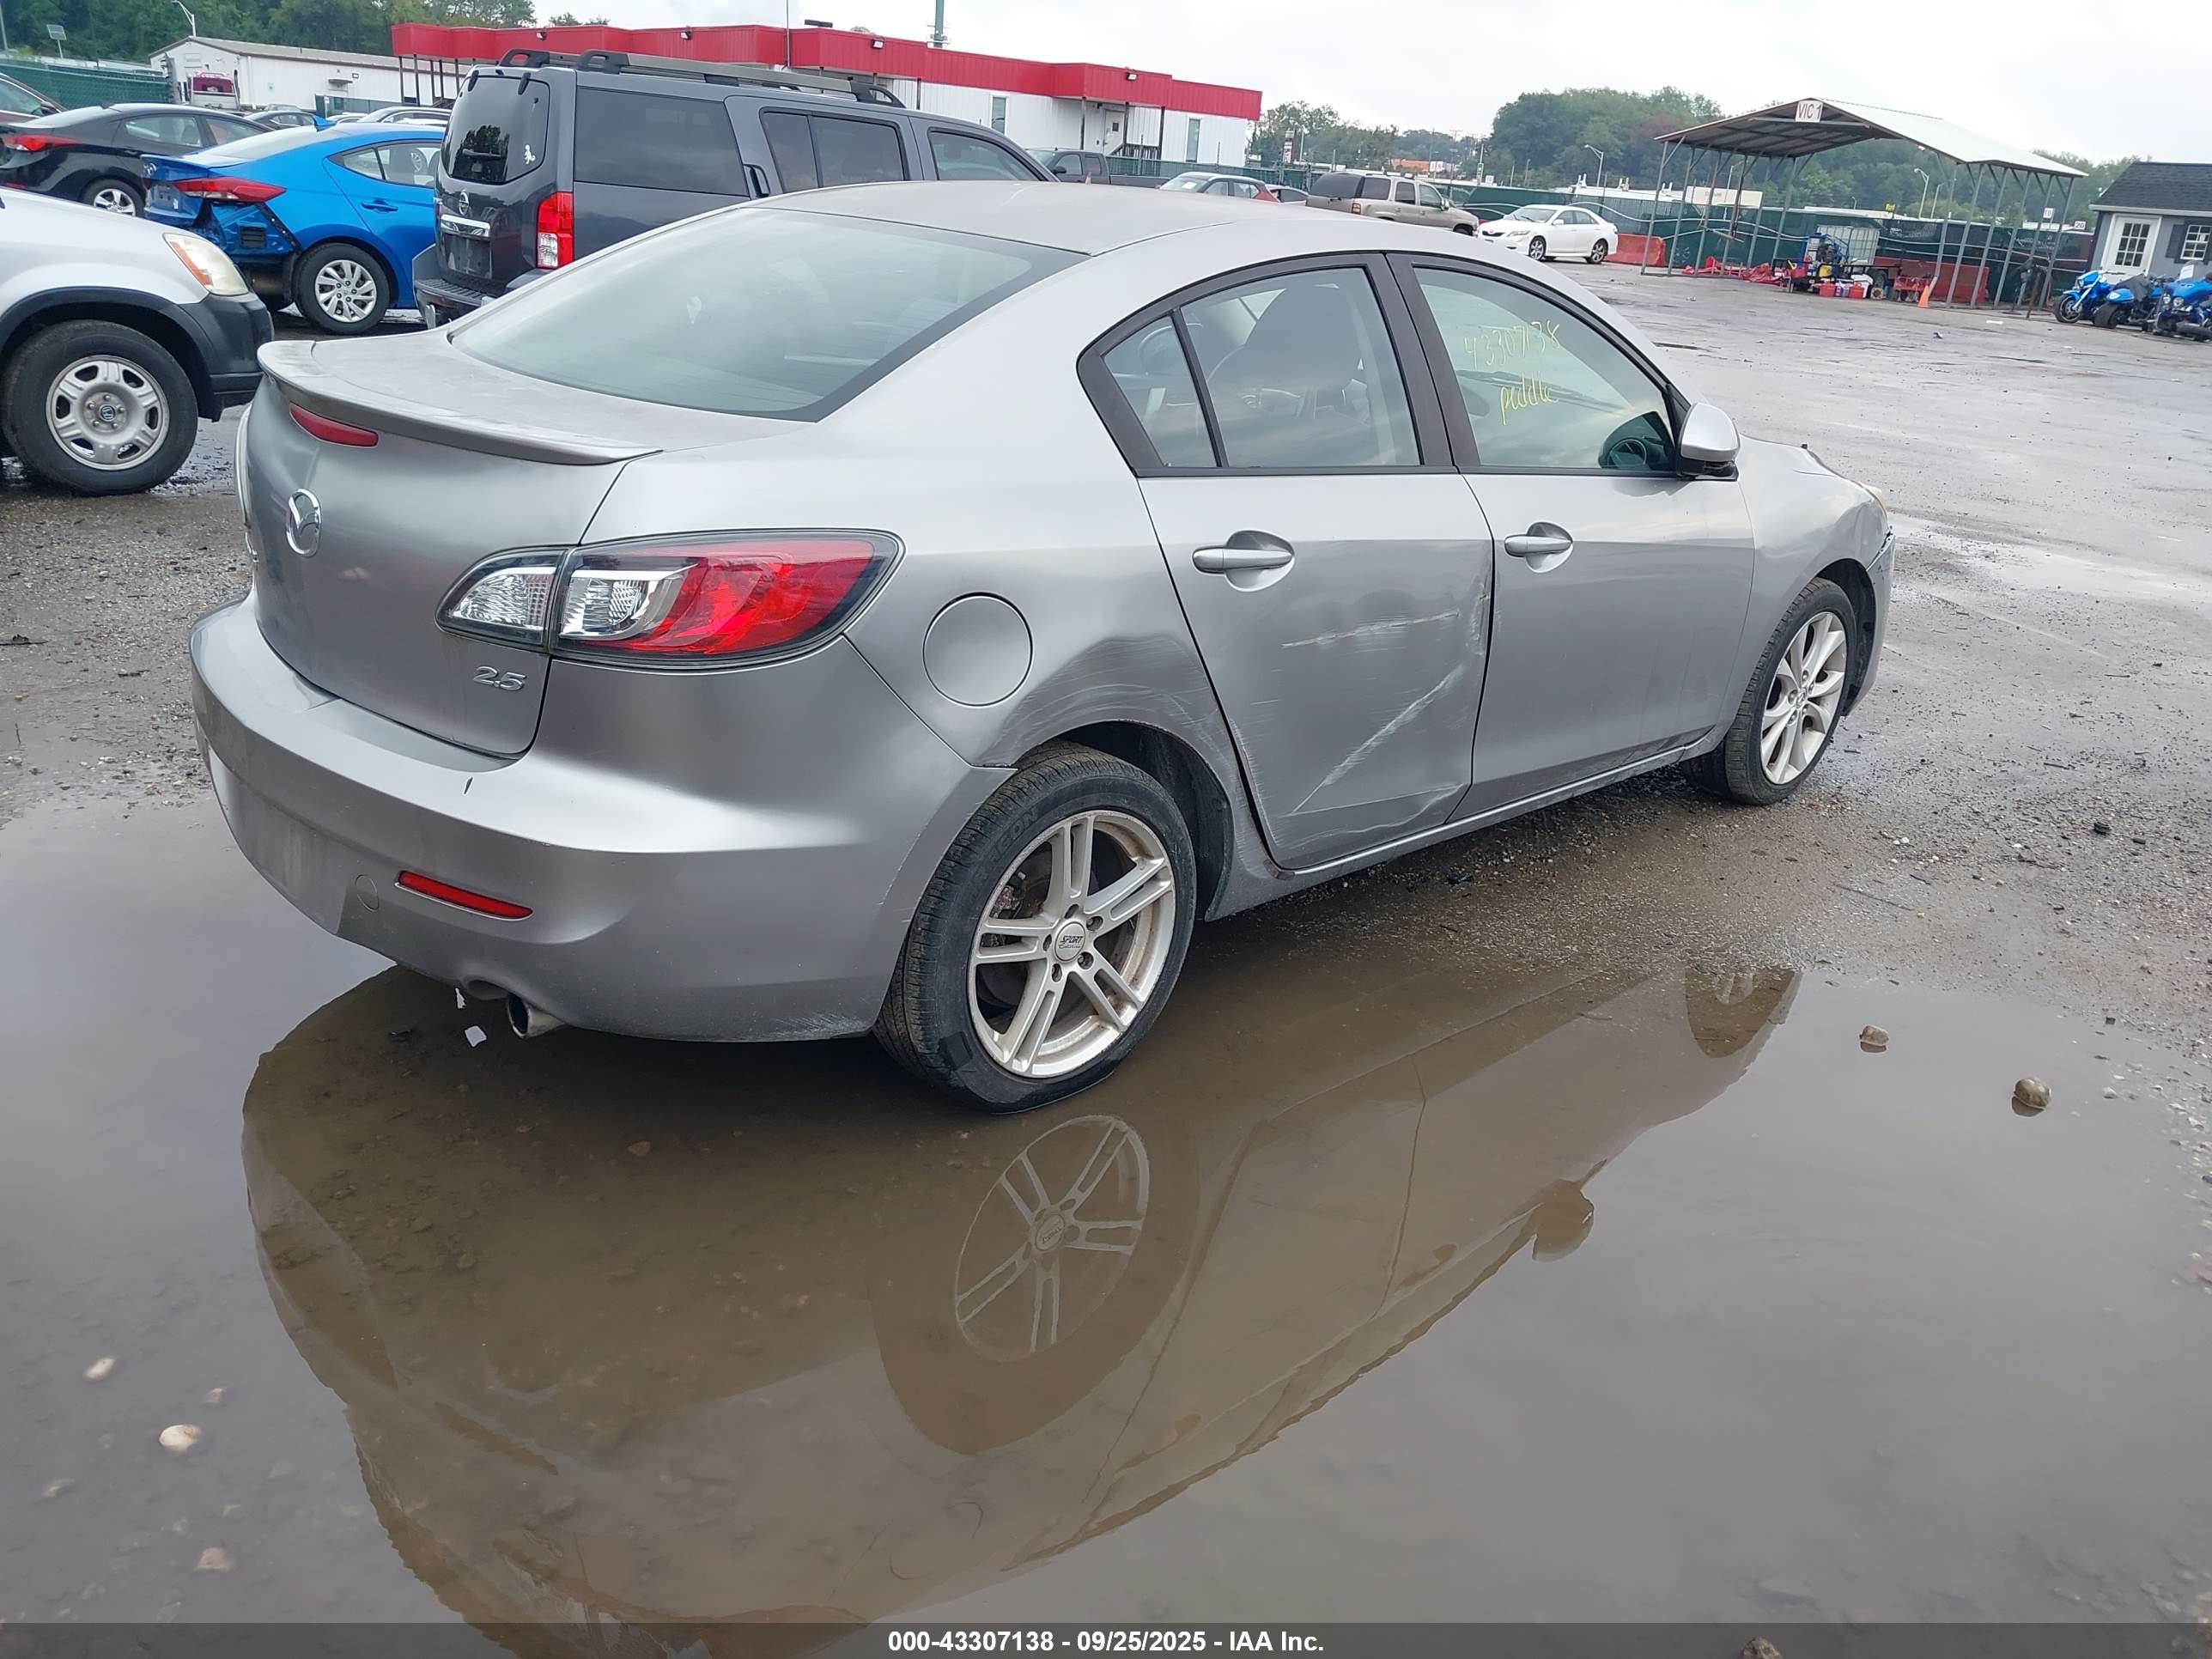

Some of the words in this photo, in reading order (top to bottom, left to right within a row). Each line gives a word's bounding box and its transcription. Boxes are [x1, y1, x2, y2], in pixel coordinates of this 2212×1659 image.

[1799, 104, 1814, 118] VIC
[1816, 104, 1822, 118] 1
[473, 665, 527, 690] 2.5
[1060, 935, 1084, 944] SPORT
